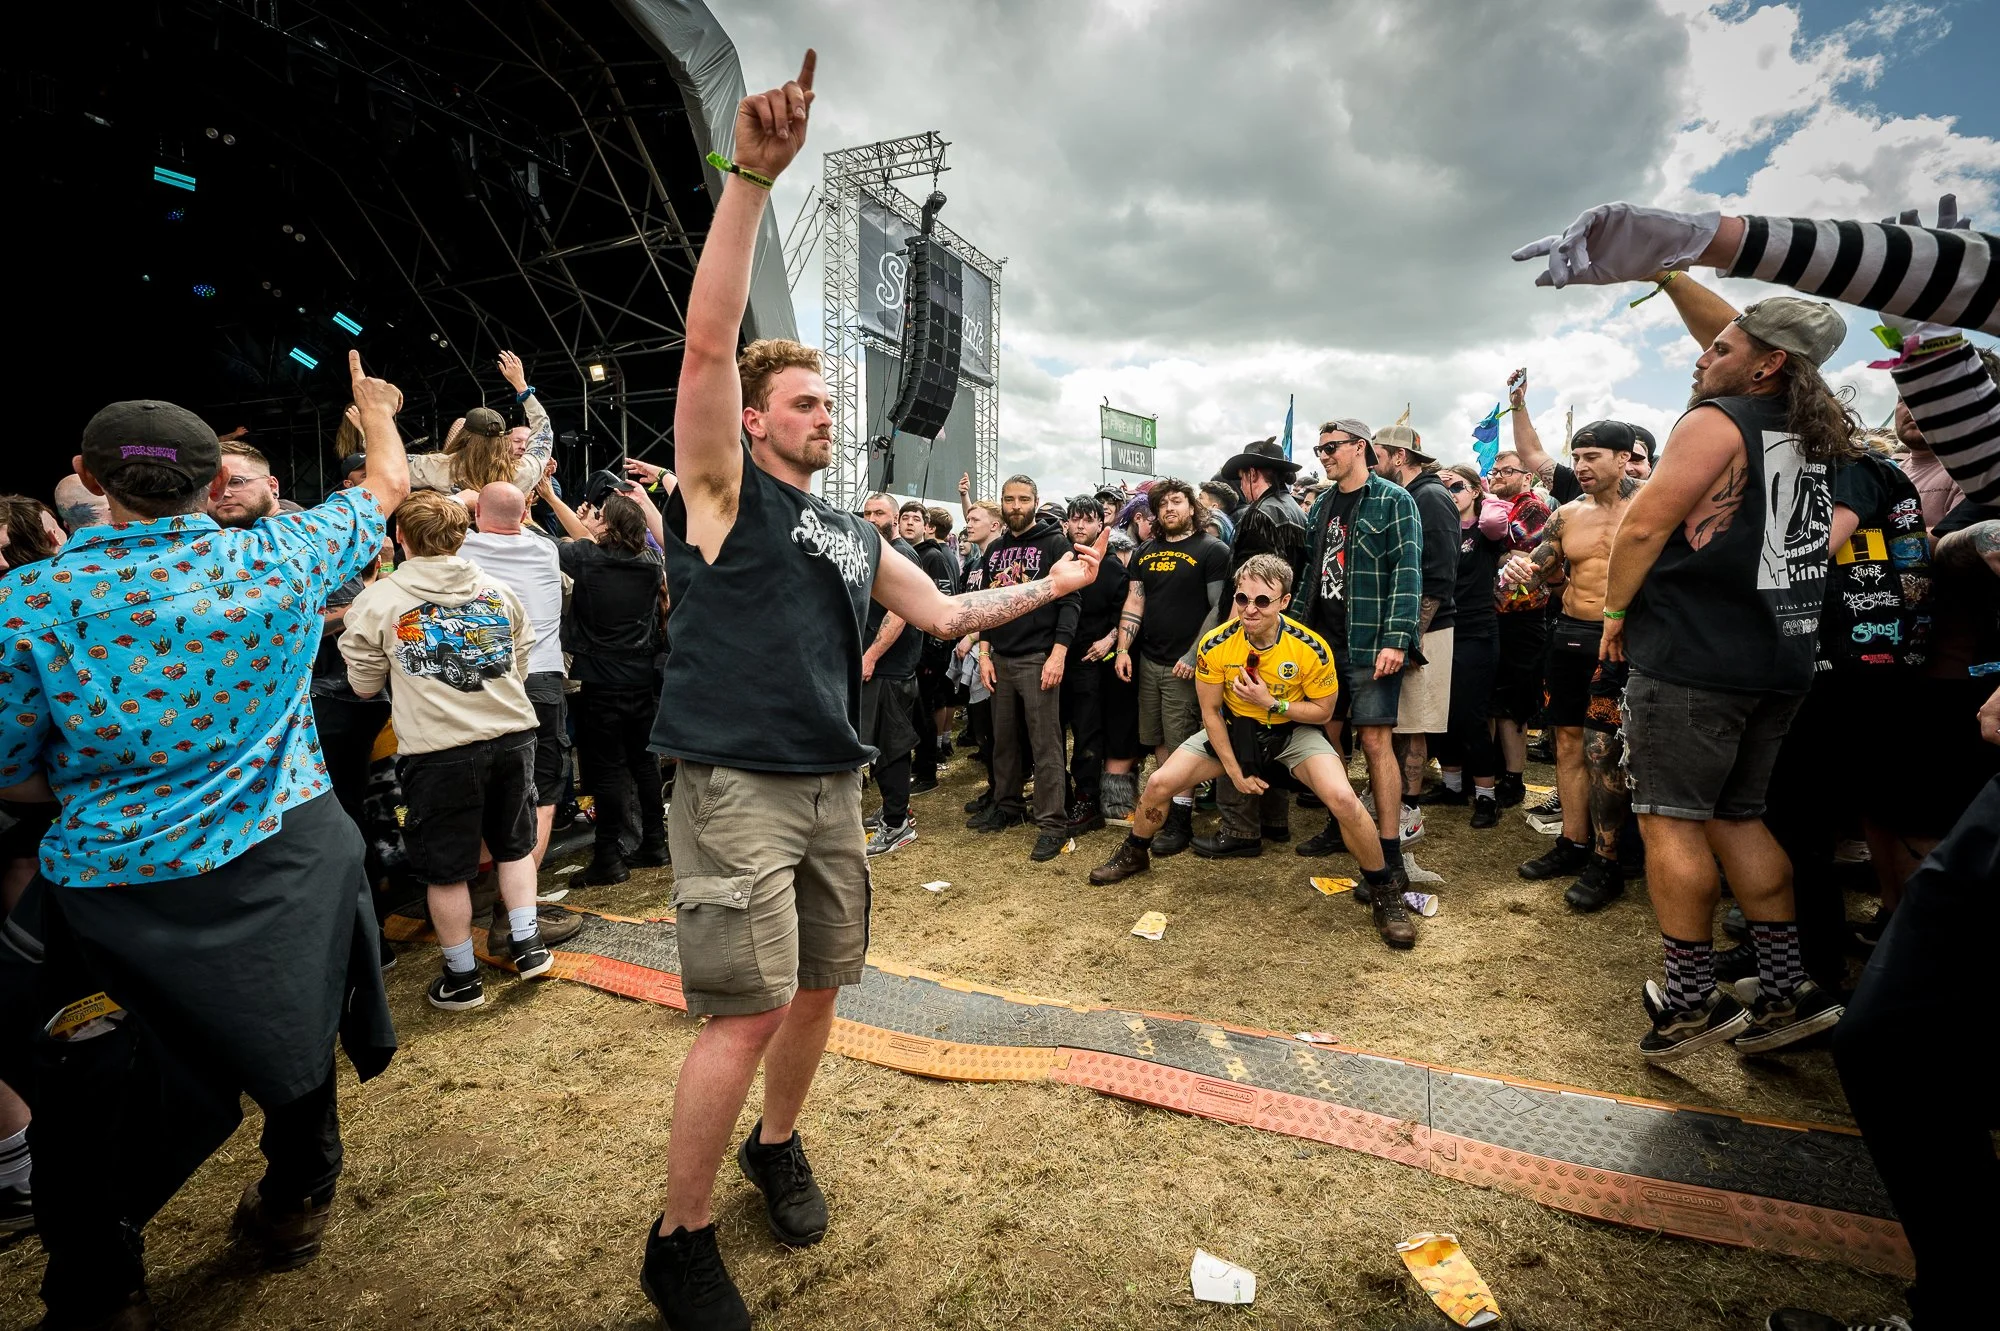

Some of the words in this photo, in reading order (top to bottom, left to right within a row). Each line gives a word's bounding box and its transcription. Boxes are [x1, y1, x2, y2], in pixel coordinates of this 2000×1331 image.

[1145, 424, 1151, 442] 8
[120, 445, 146, 459] ENTER
[145, 447, 178, 462] SHIKARI
[1117, 447, 1146, 468] WATER
[988, 558, 1040, 572] SHIKRI
[1149, 561, 1177, 571] 1965
